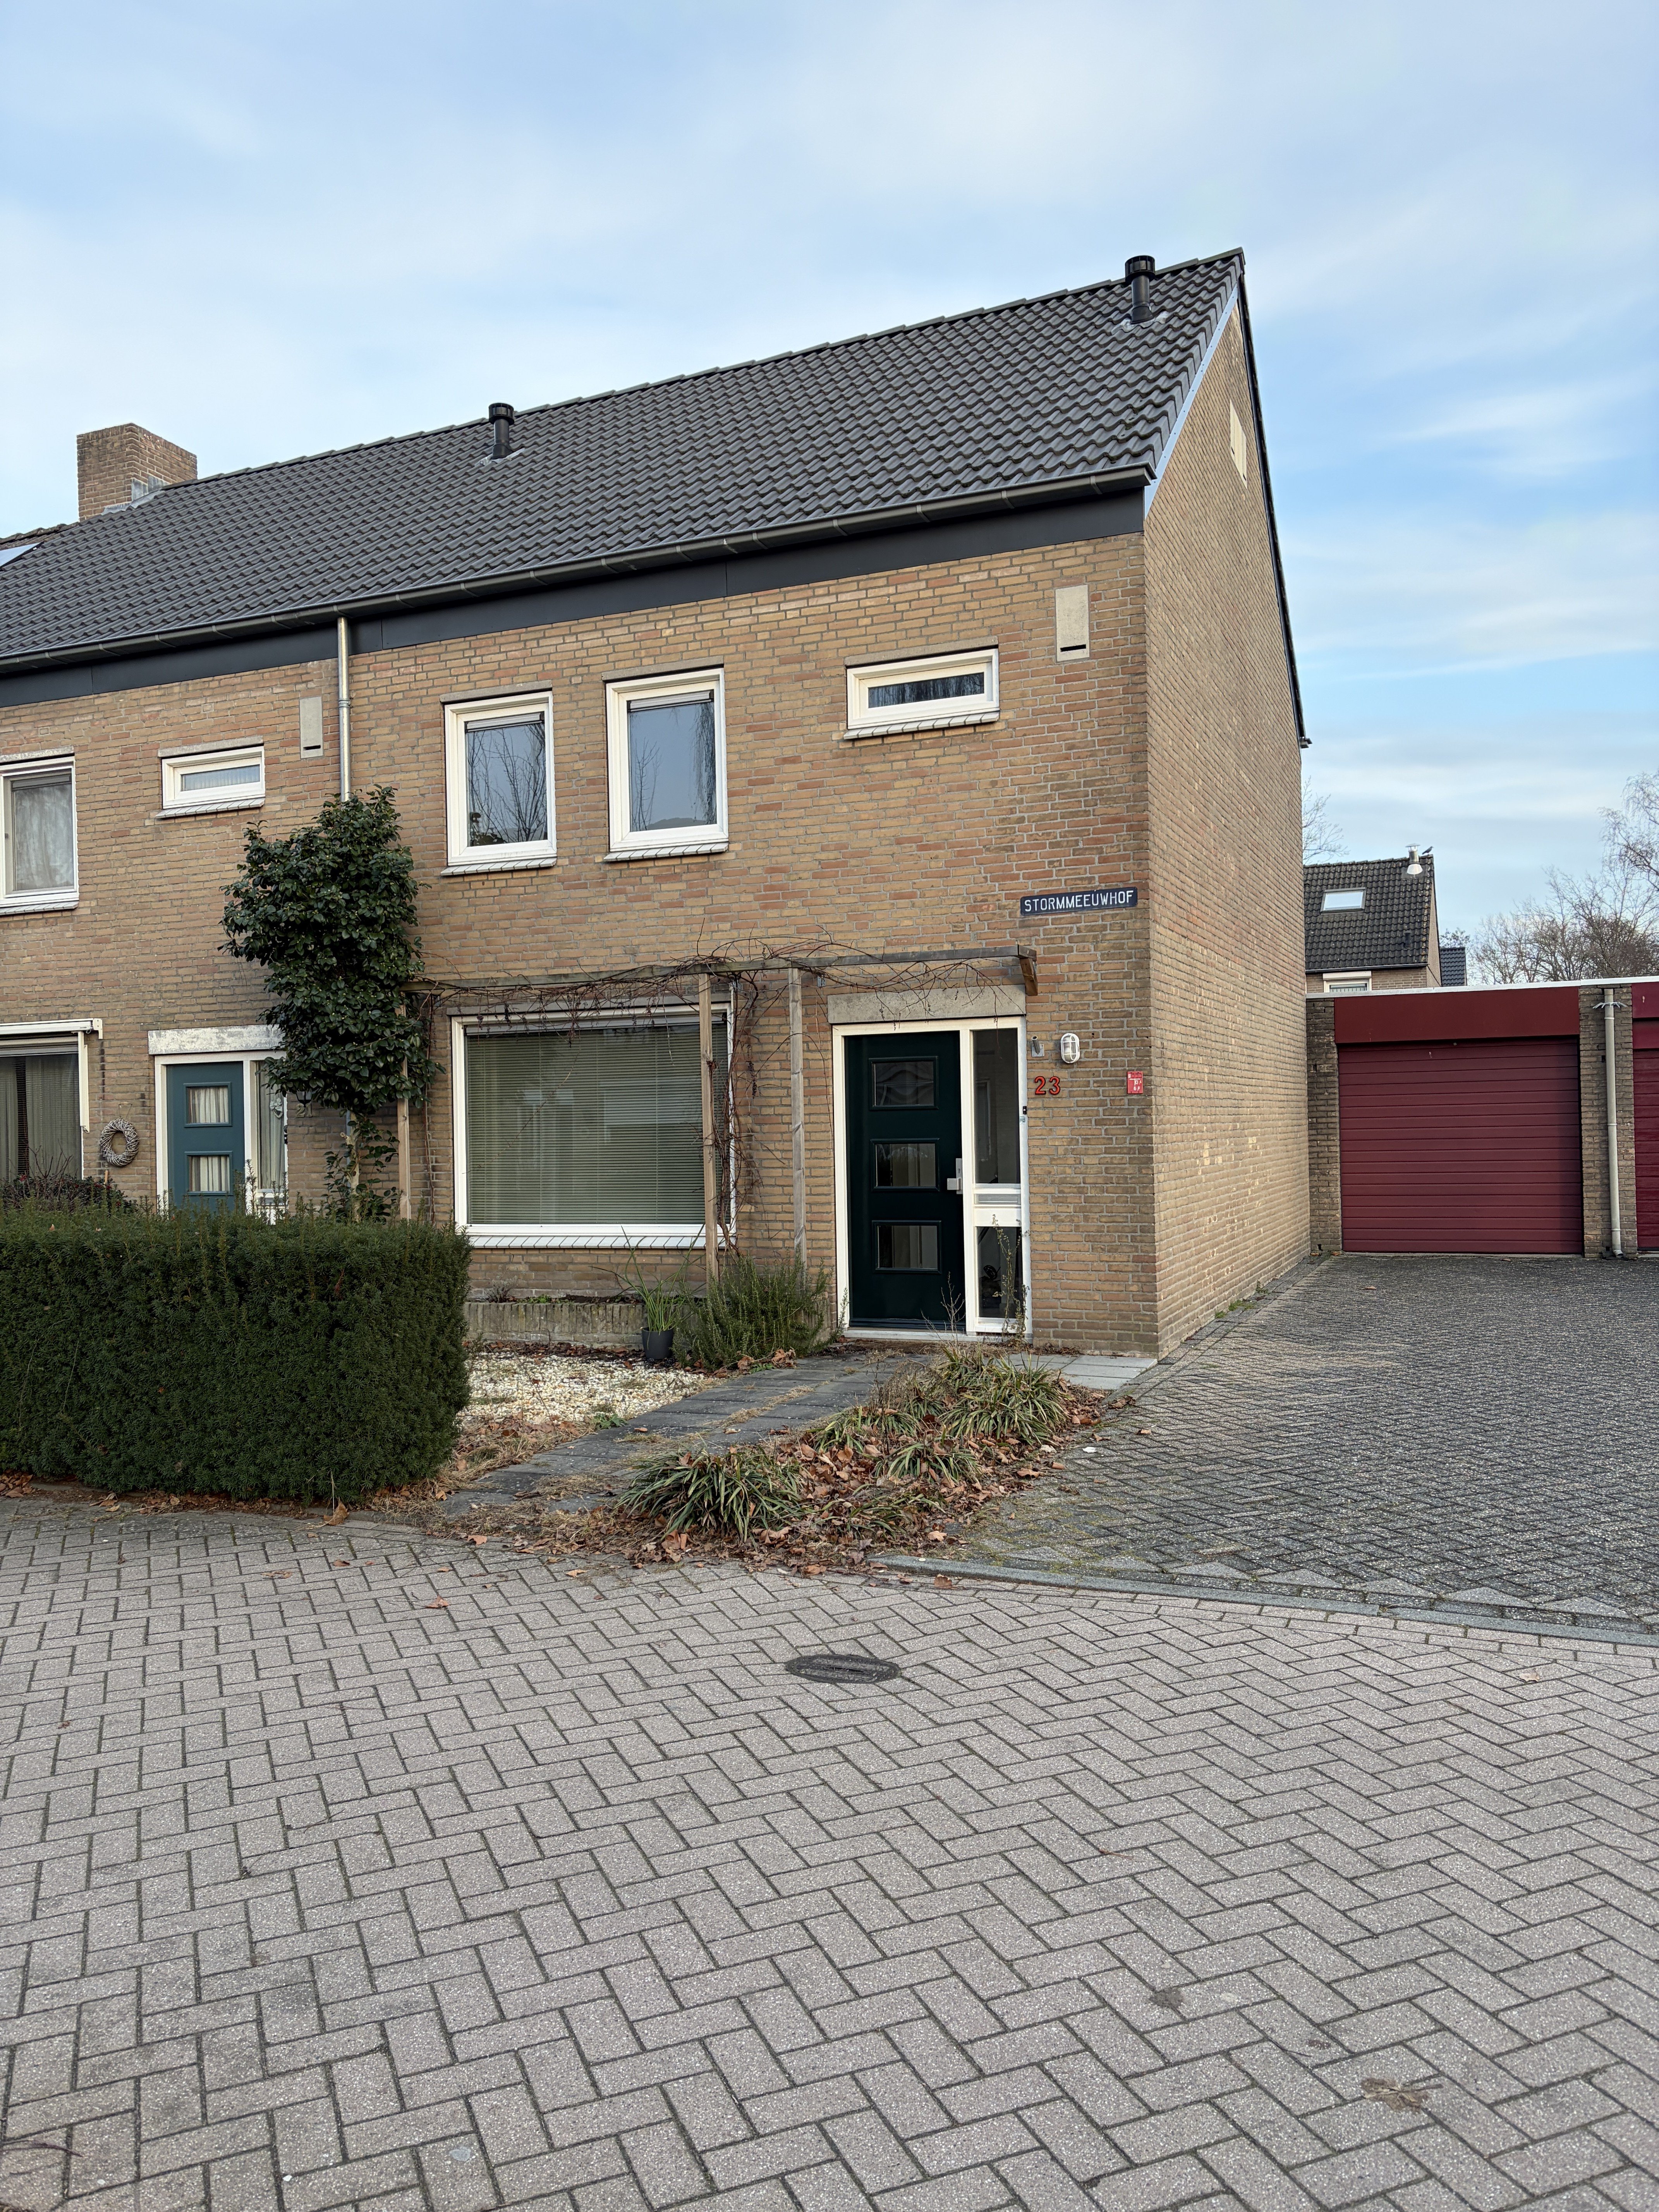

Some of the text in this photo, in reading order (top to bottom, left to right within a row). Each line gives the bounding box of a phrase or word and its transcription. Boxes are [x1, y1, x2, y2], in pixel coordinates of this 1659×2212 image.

[1025, 890, 1133, 912] STORMMEEUWHOF
[1034, 1076, 1060, 1095] 23
[296, 1103, 313, 1118] 21
